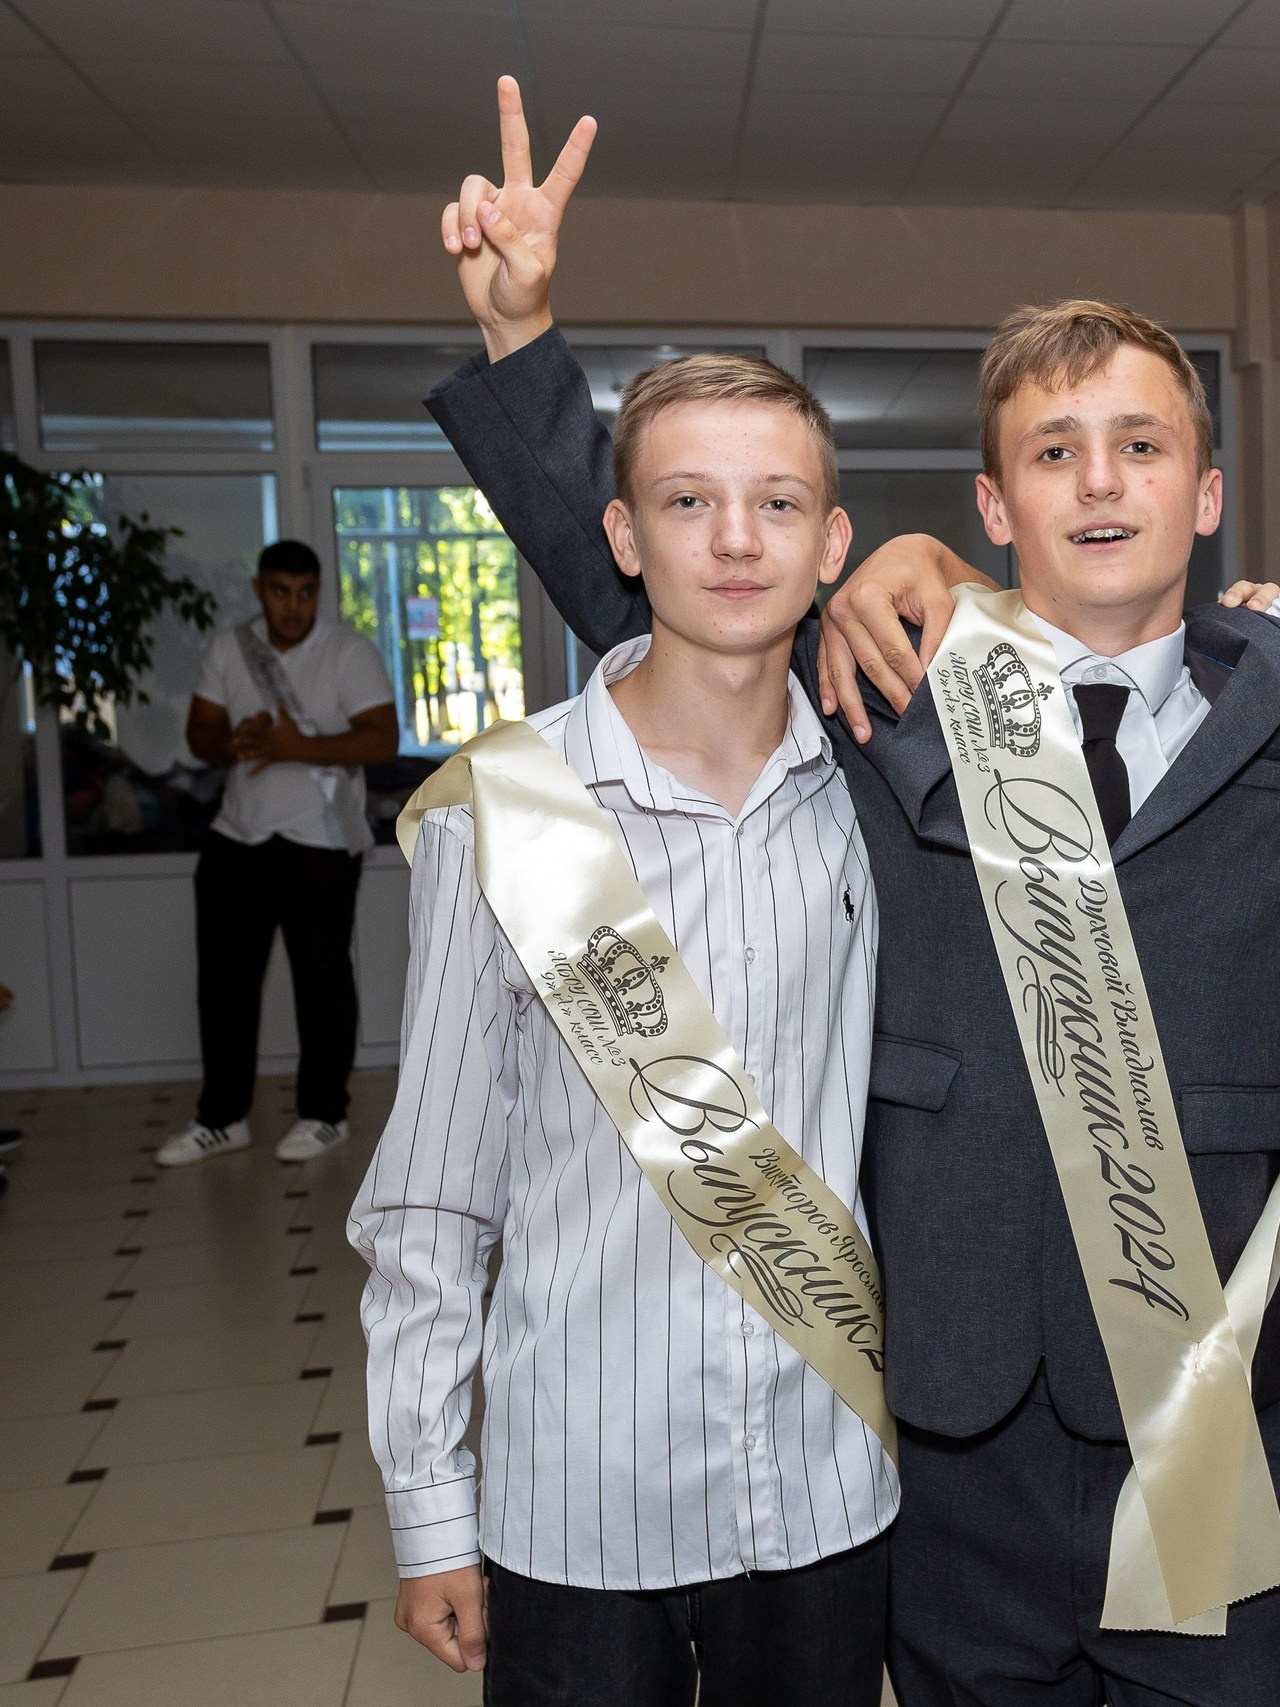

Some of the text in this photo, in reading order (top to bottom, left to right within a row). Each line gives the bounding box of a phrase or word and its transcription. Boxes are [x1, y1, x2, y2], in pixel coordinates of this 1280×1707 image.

[949, 651, 977, 702] МБОУ
[949, 718, 971, 765] класс
[962, 702, 985, 739] СОШ
[547, 950, 590, 996] МБОУ
[576, 999, 610, 1032] СОШ
[1075, 876, 1165, 1152] Духовой Владислав
[569, 1021, 604, 1066] класс
[748, 1147, 839, 1236] Викторов
[1092, 1144, 1190, 1322] 2024
